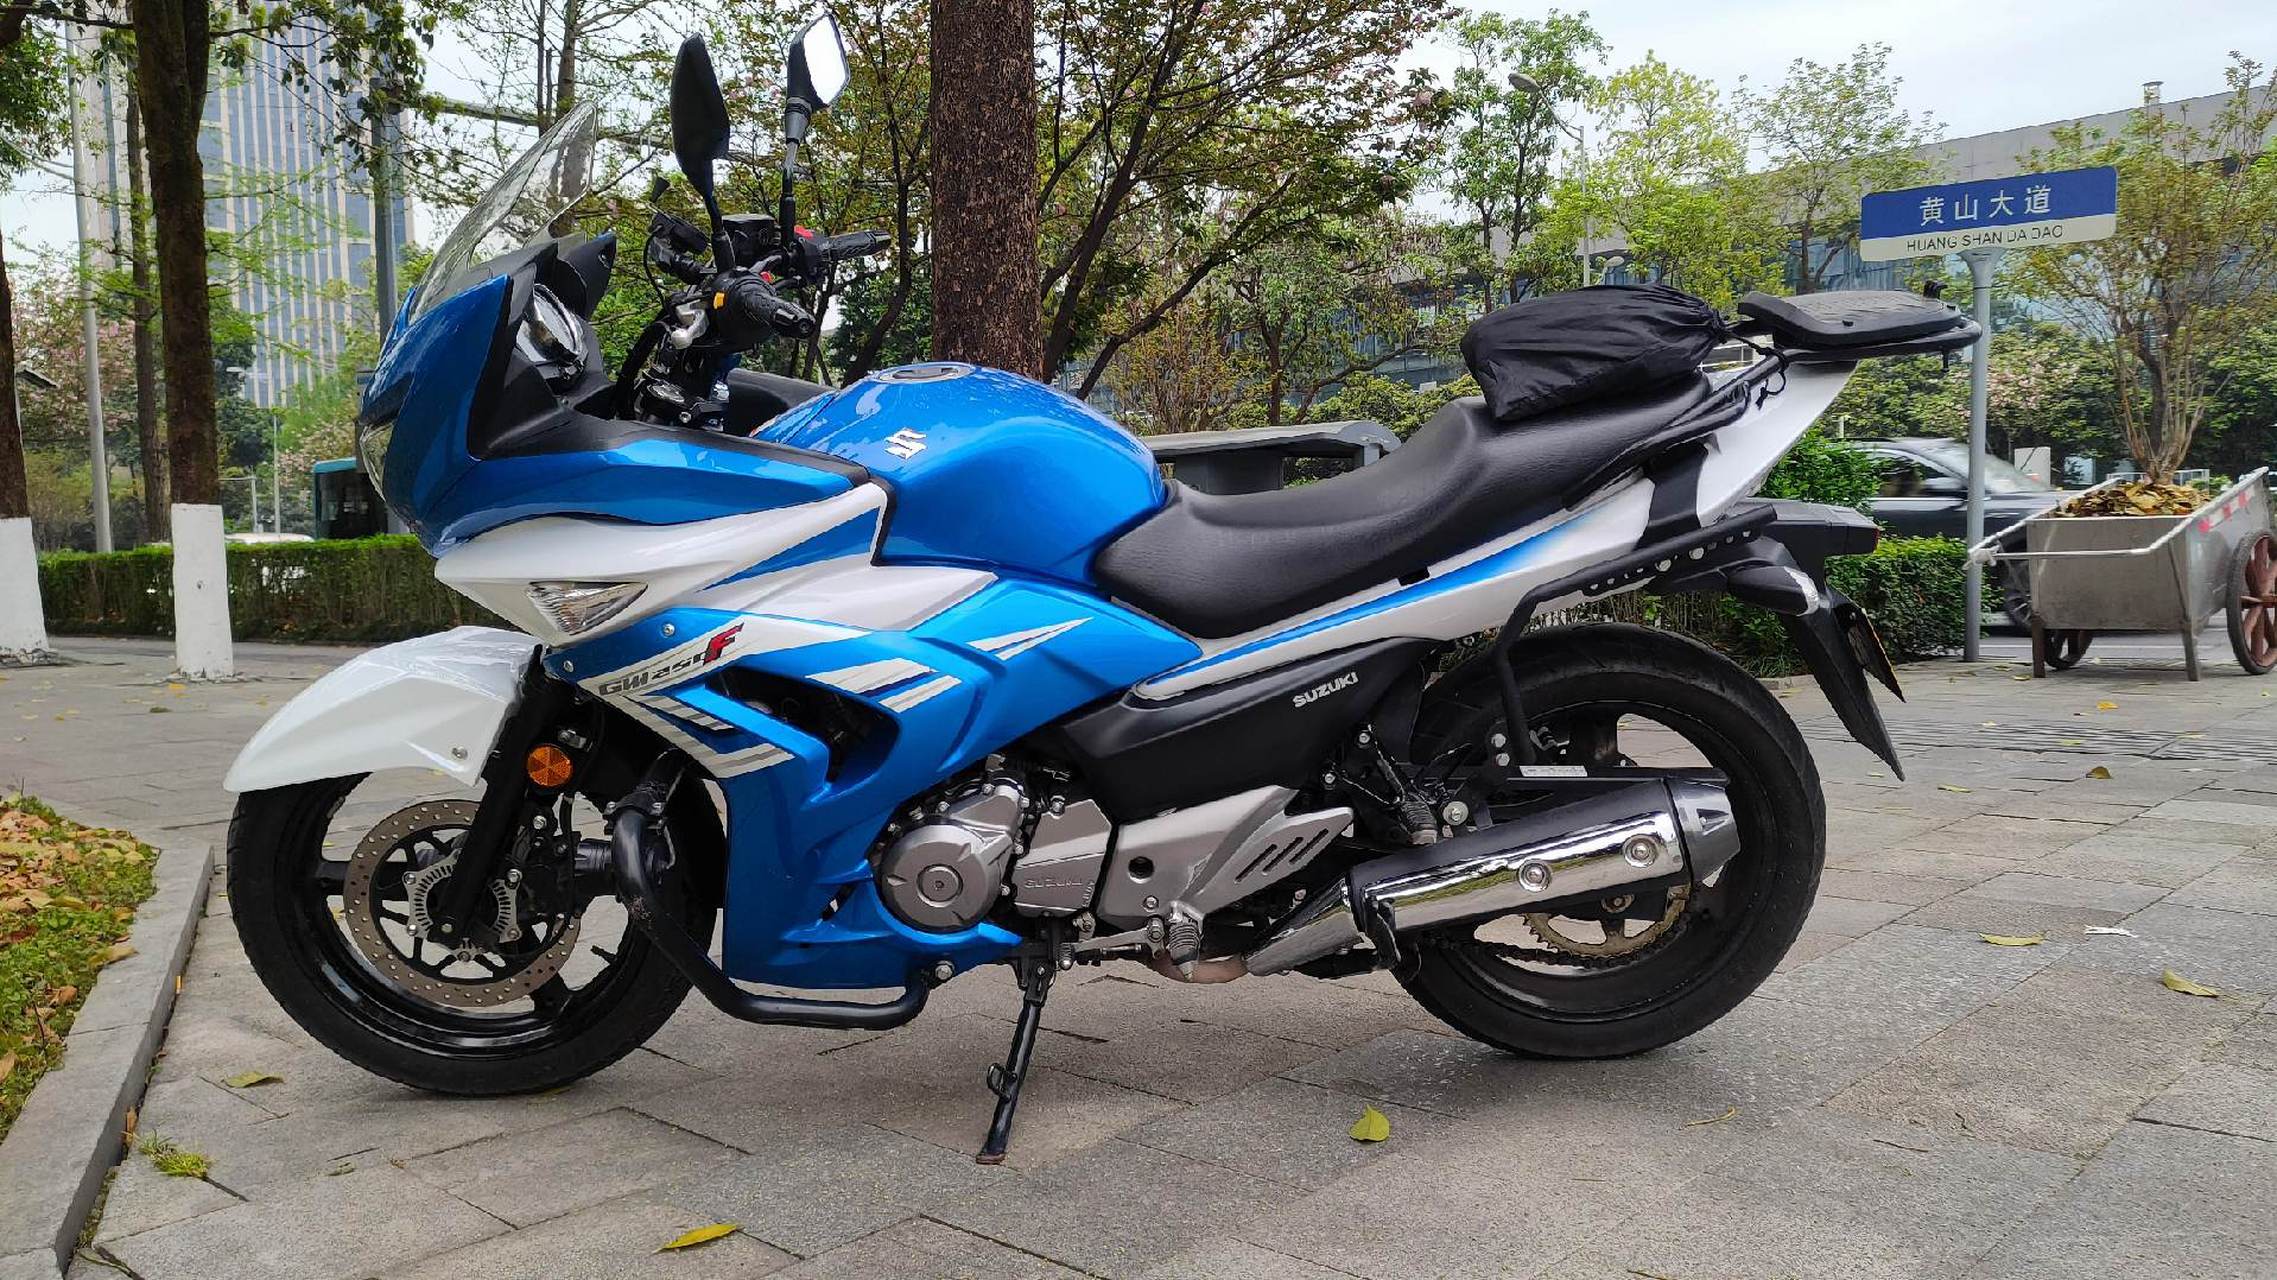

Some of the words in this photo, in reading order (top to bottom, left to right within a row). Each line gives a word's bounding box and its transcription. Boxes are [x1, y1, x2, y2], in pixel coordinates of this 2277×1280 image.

[1919, 184, 2051, 227] 黄山大道
[1907, 236, 1958, 251] HUANG
[1962, 231, 2003, 246] SHAN
[2007, 229, 2027, 243] DA
[2031, 225, 2063, 240] DAO
[1292, 671, 1359, 708] SUZUKI
